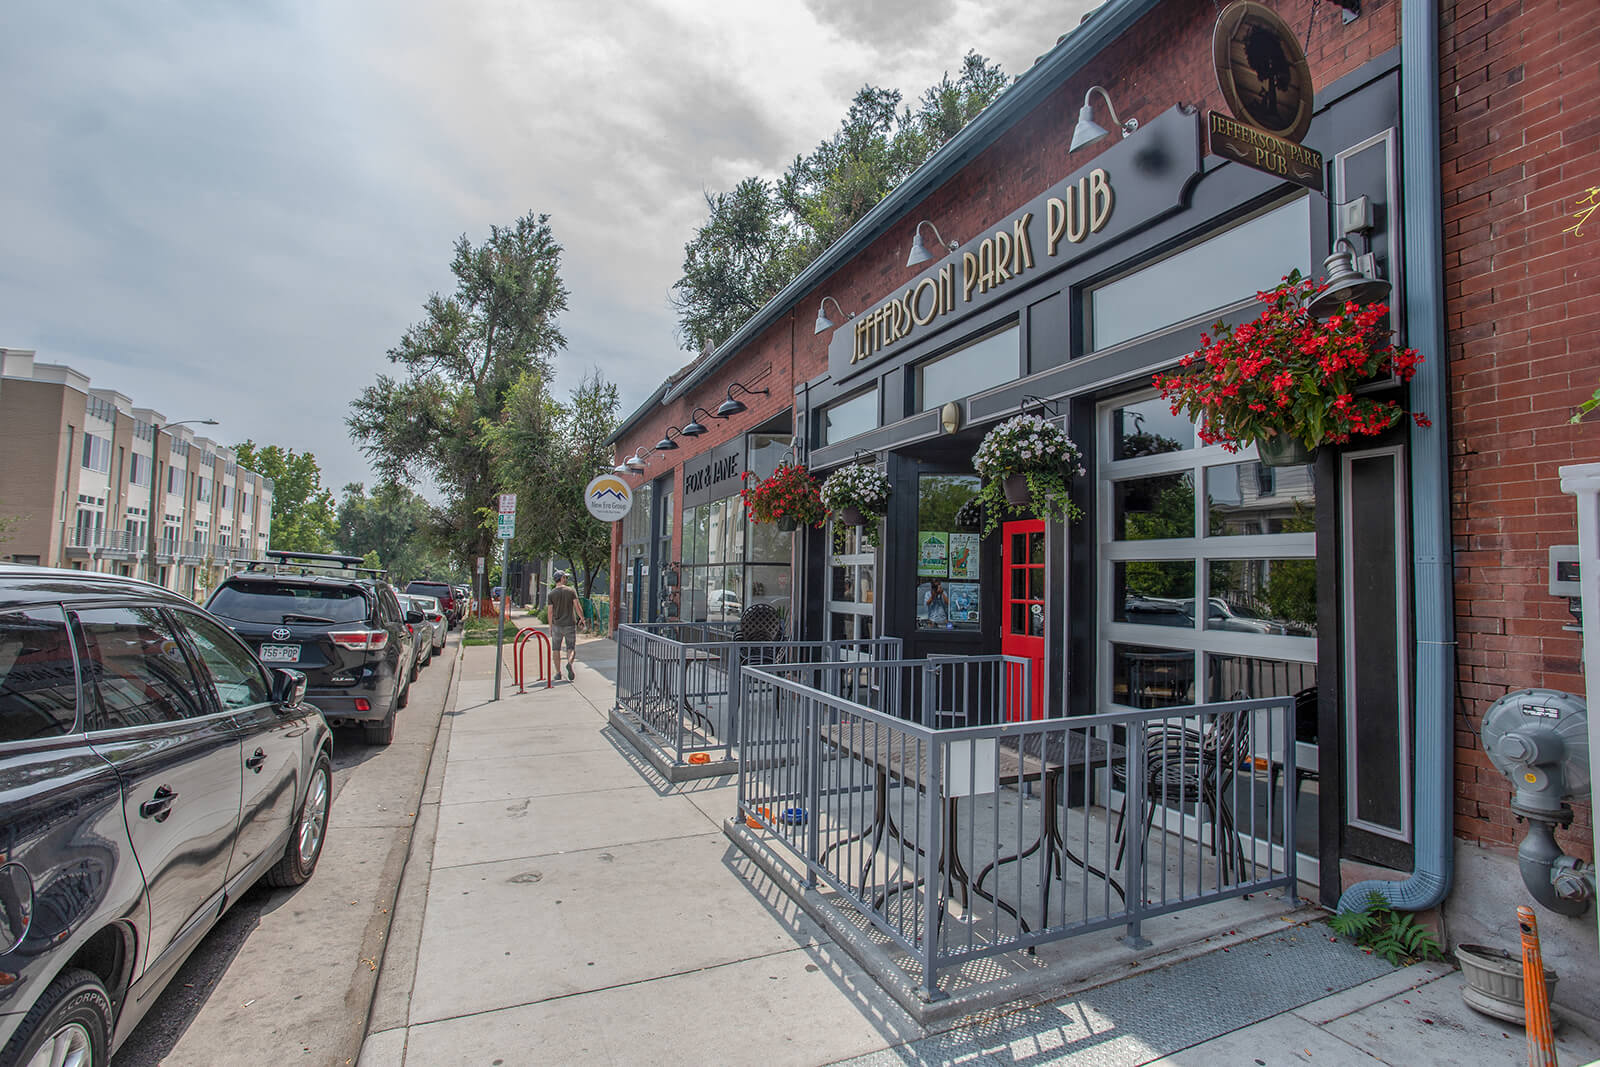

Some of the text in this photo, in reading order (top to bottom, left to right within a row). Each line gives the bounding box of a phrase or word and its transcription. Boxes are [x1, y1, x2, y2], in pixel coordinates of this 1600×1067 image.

[1211, 114, 1322, 170] JEFFERSON PARK
[1254, 147, 1288, 175] PUB
[850, 167, 1113, 365] JEFFERSON PARK PUB
[686, 452, 739, 495] FOX & JANE
[602, 501, 611, 509] Era
[611, 502, 627, 511] Group
